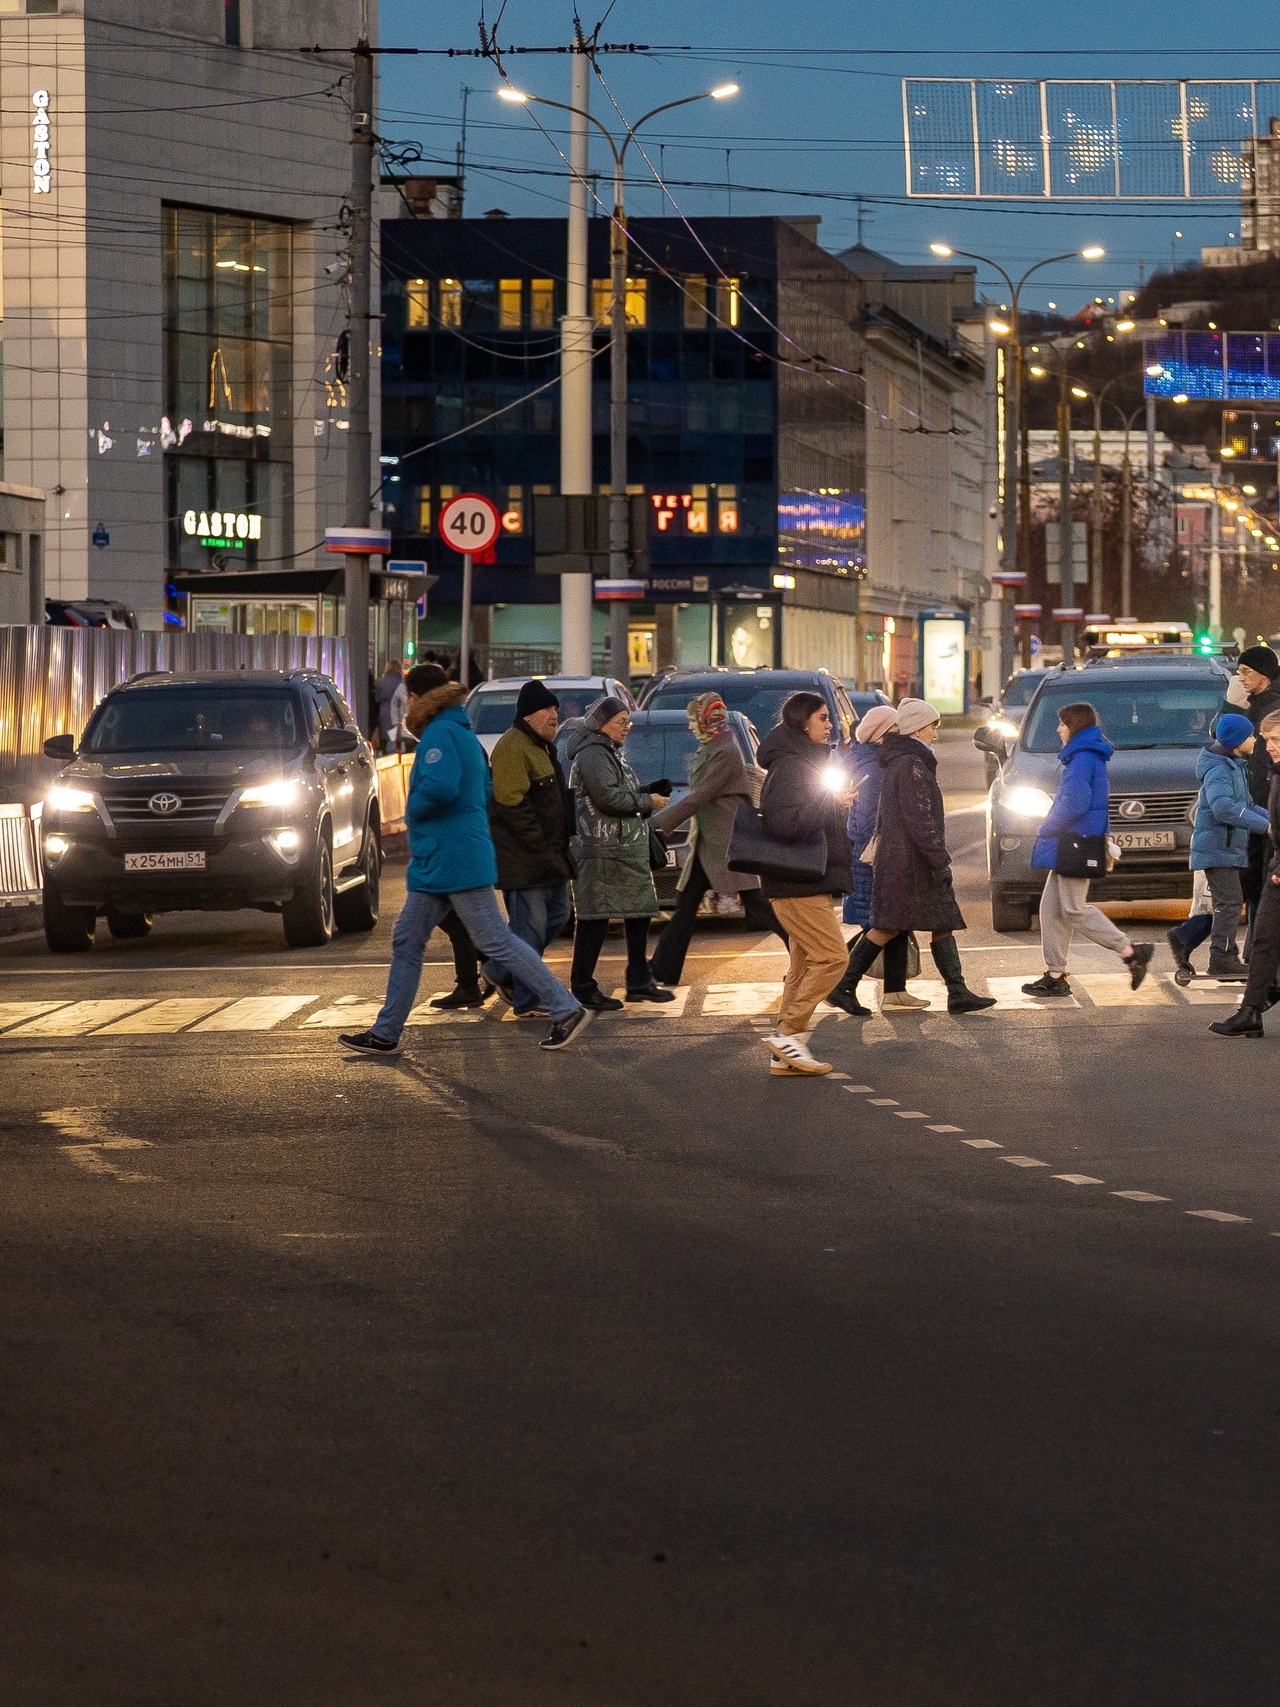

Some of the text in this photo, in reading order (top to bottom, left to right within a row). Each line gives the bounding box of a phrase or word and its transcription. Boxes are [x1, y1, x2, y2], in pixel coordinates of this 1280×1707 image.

[33, 89, 50, 193] GASTON
[184, 509, 262, 539] GASTON
[450, 511, 485, 535] 40
[187, 852, 201, 863] 51
